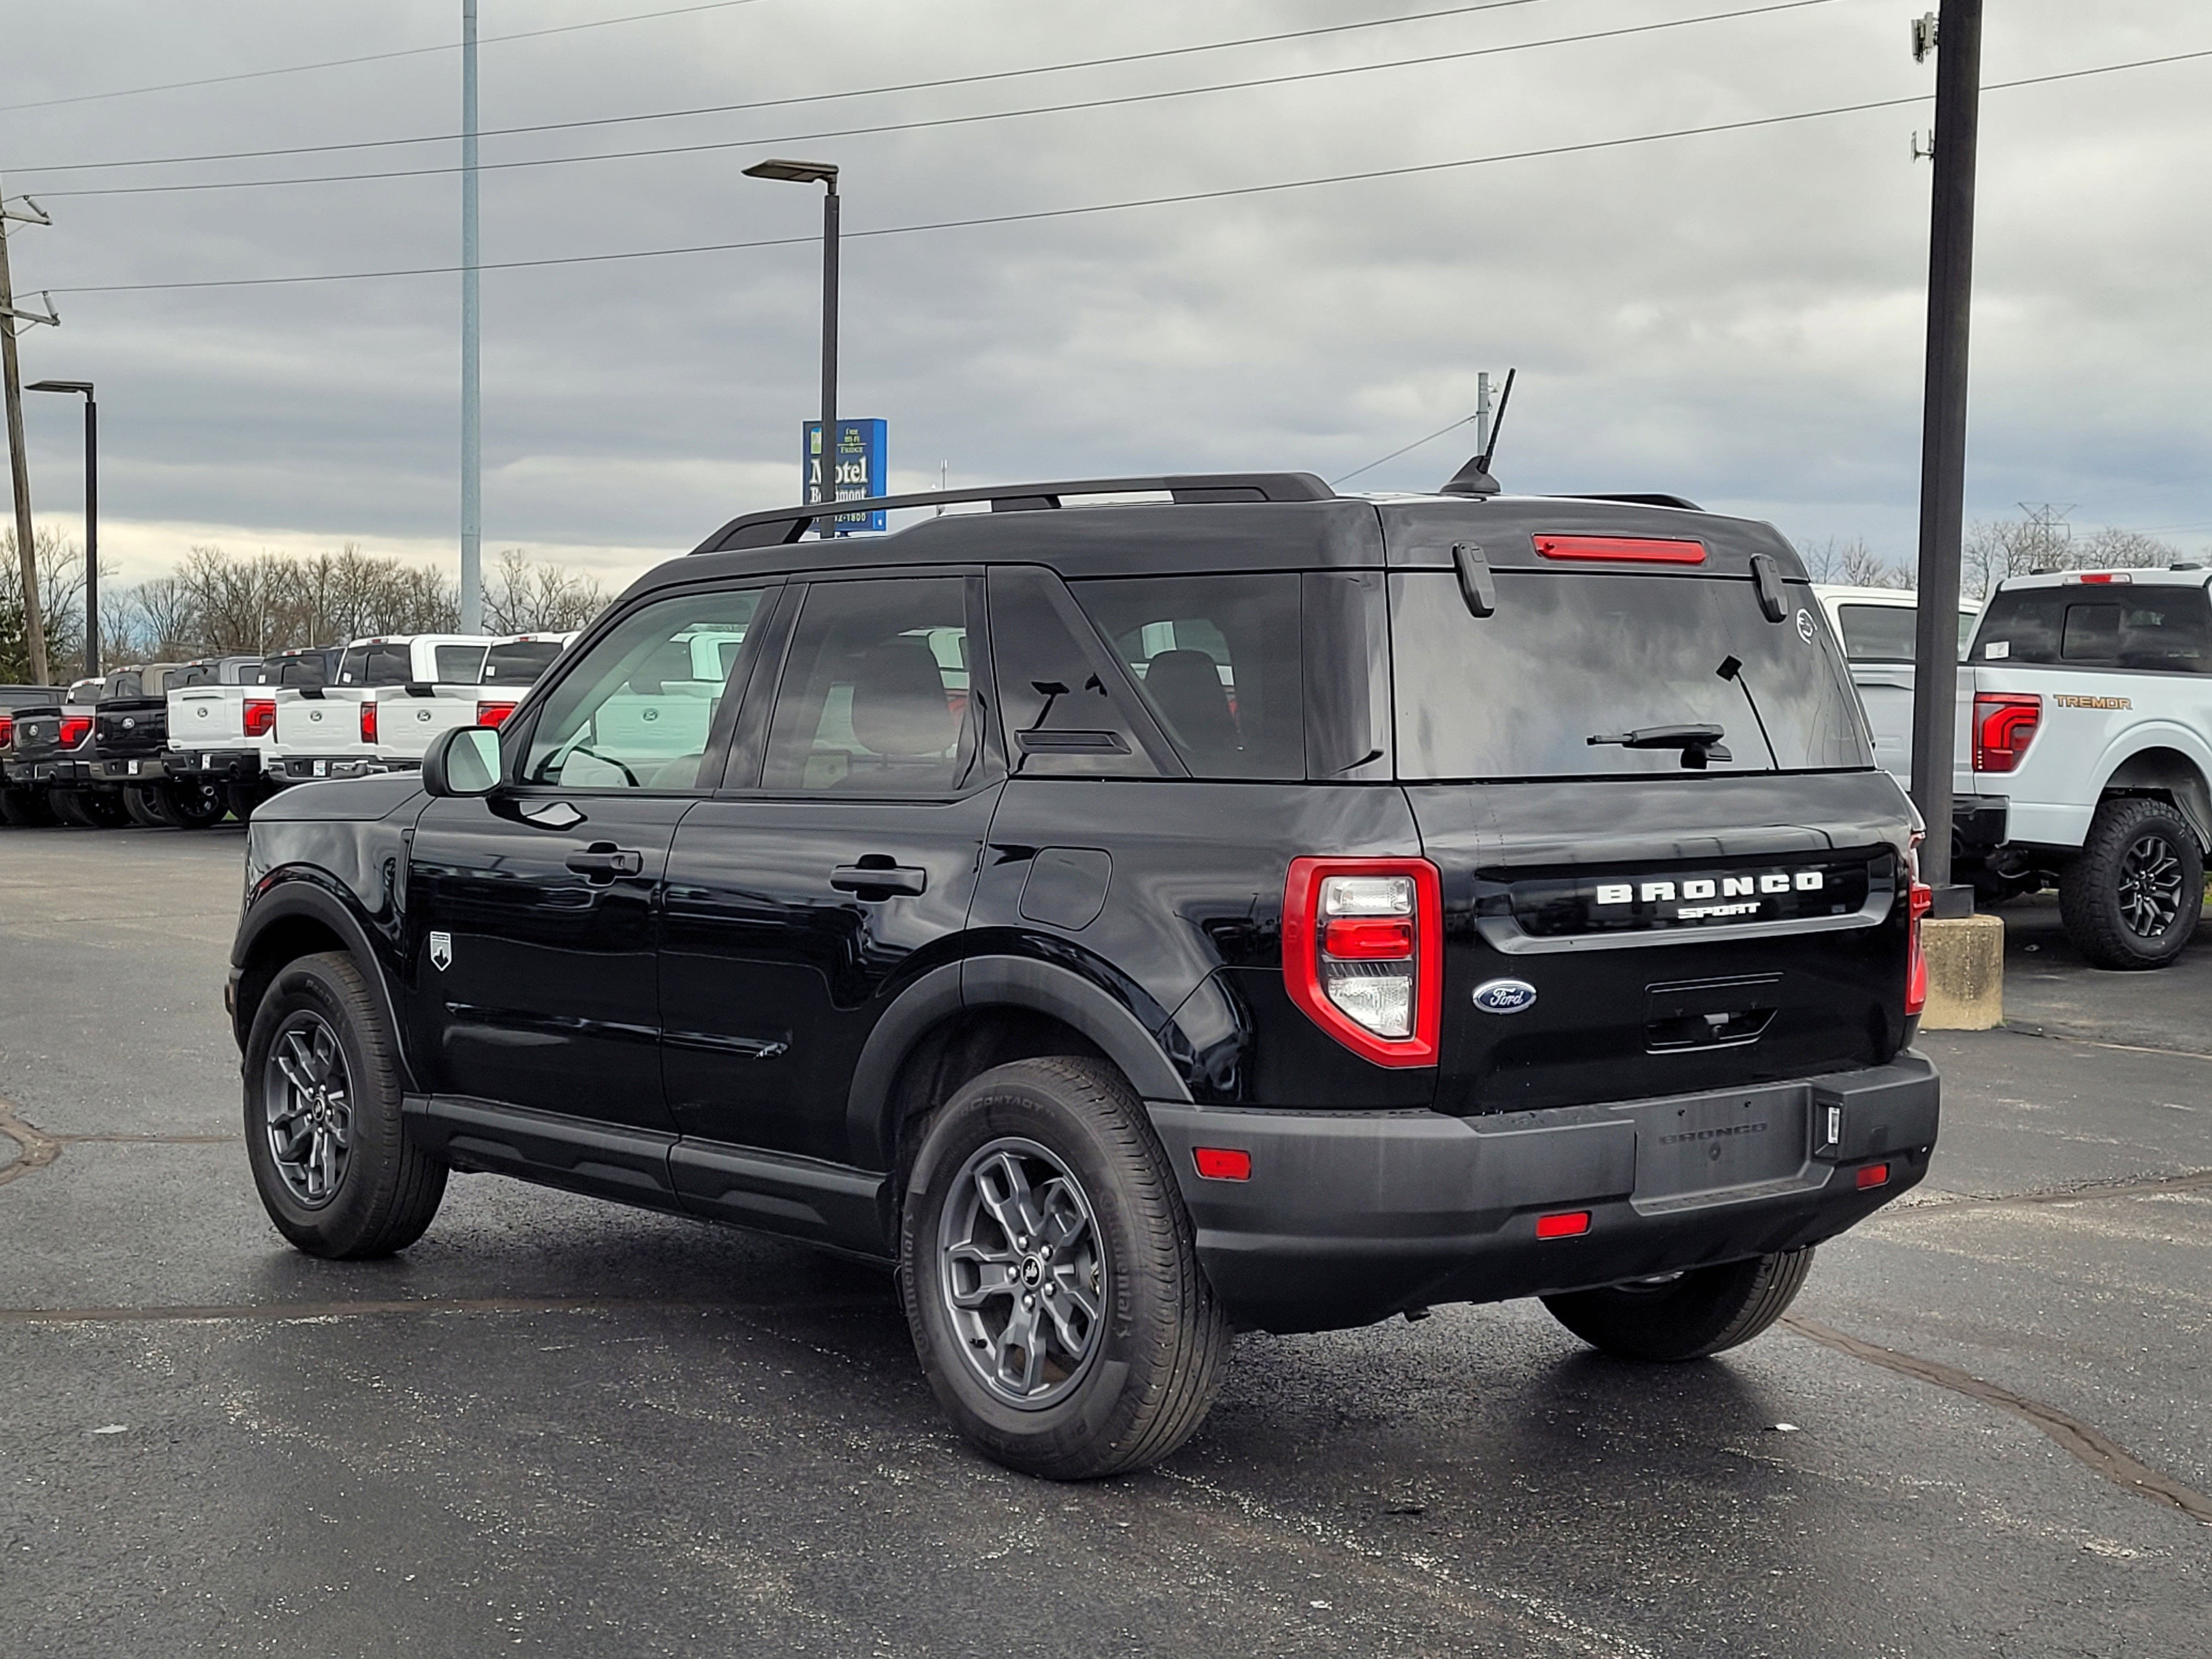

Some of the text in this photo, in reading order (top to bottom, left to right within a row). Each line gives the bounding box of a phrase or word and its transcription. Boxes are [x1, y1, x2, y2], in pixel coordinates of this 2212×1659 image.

[2053, 694, 2133, 710] TREMOR
[1597, 872, 1823, 904] BRONCO
[1677, 902, 1760, 919] SPORT
[1489, 988, 1524, 1006] Ford
[1659, 1122, 1768, 1146] BRONCO
